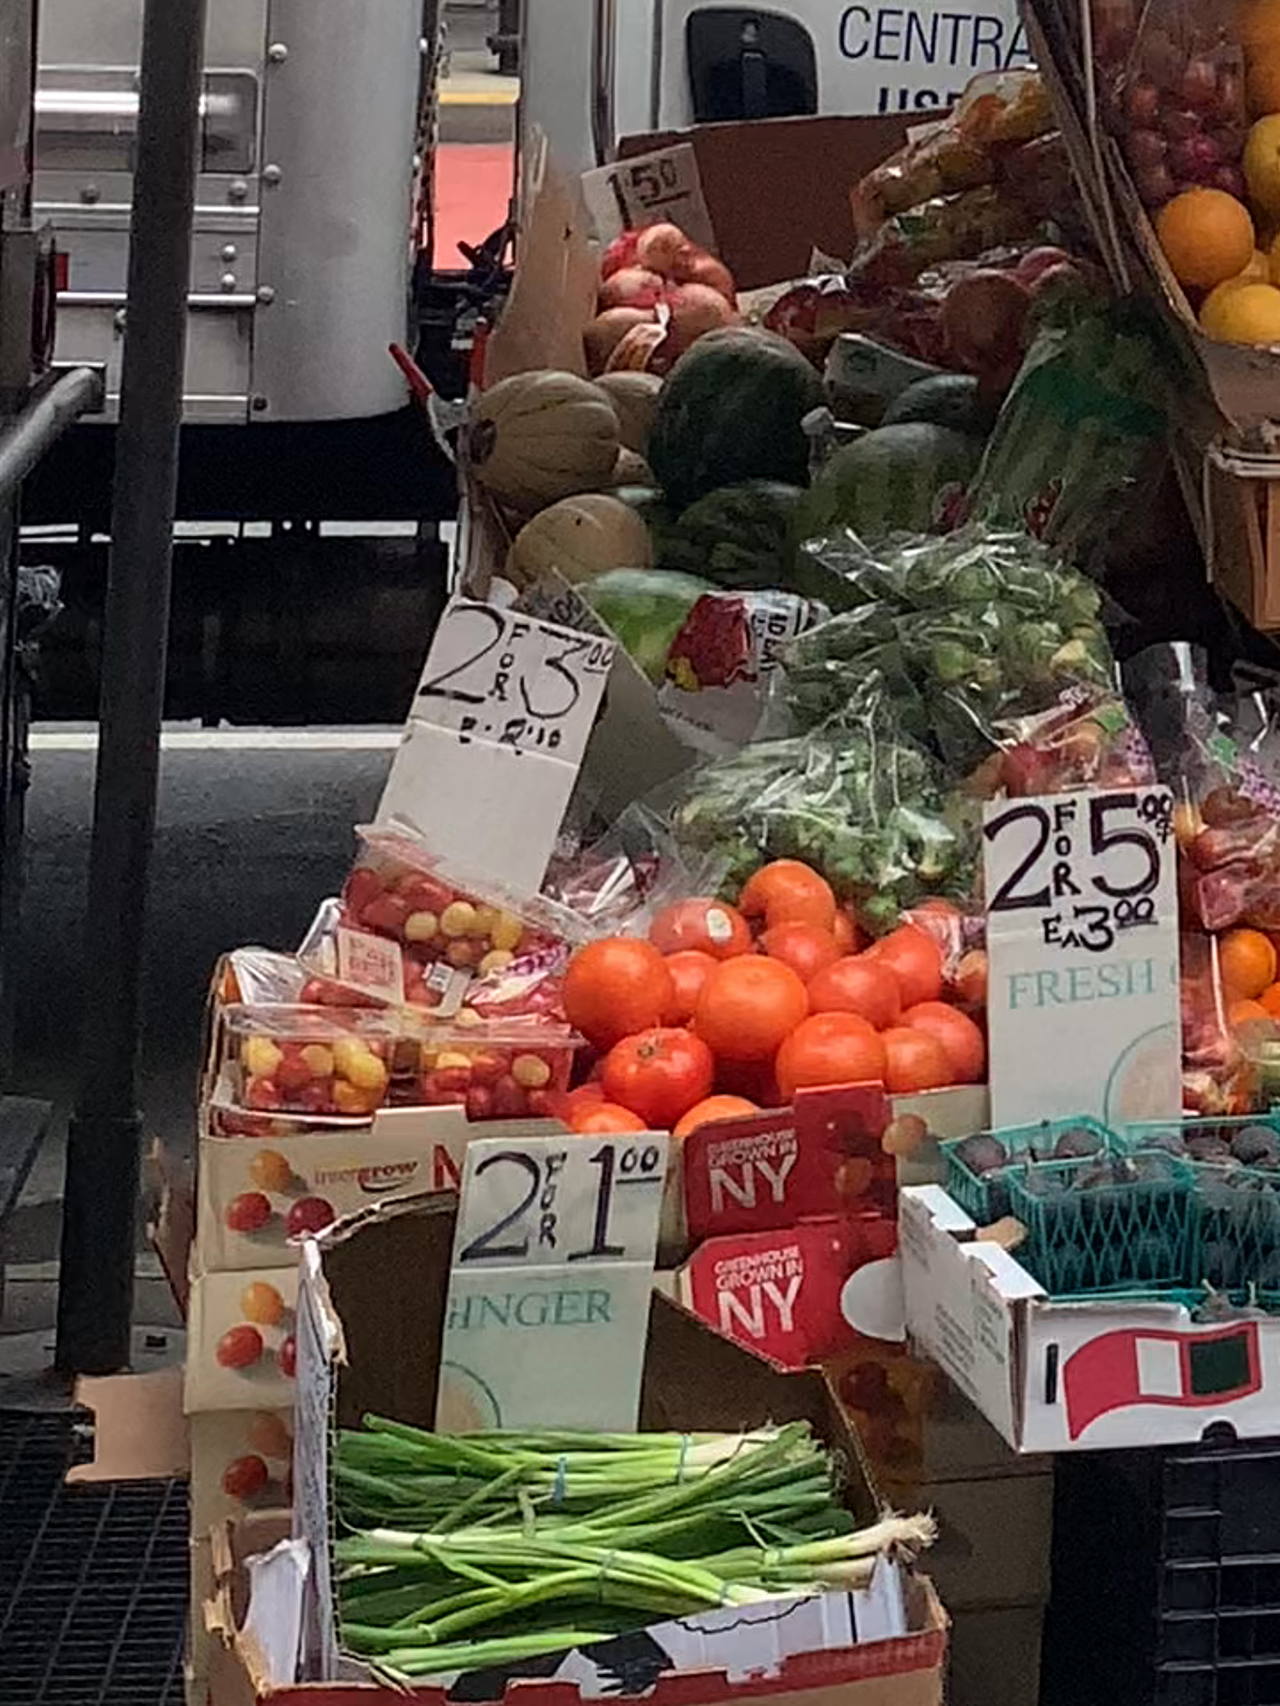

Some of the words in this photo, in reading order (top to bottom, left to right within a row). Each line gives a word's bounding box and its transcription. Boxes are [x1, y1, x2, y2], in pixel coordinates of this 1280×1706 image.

[418, 603, 506, 705] 2
[487, 622, 531, 702] FOR
[982, 803, 1052, 912] 2
[1052, 799, 1082, 897] FOR
[1006, 957, 1157, 1010] FRESH
[708, 1152, 798, 1213] NY
[709, 1145, 776, 1170] GROWN
[459, 1150, 542, 1262] 2
[537, 1151, 568, 1249] FOR
[714, 1244, 800, 1275] GREENHOUSE
[716, 1263, 785, 1290] GROWN
[785, 1259, 804, 1277] IN
[717, 1275, 804, 1339] NY
